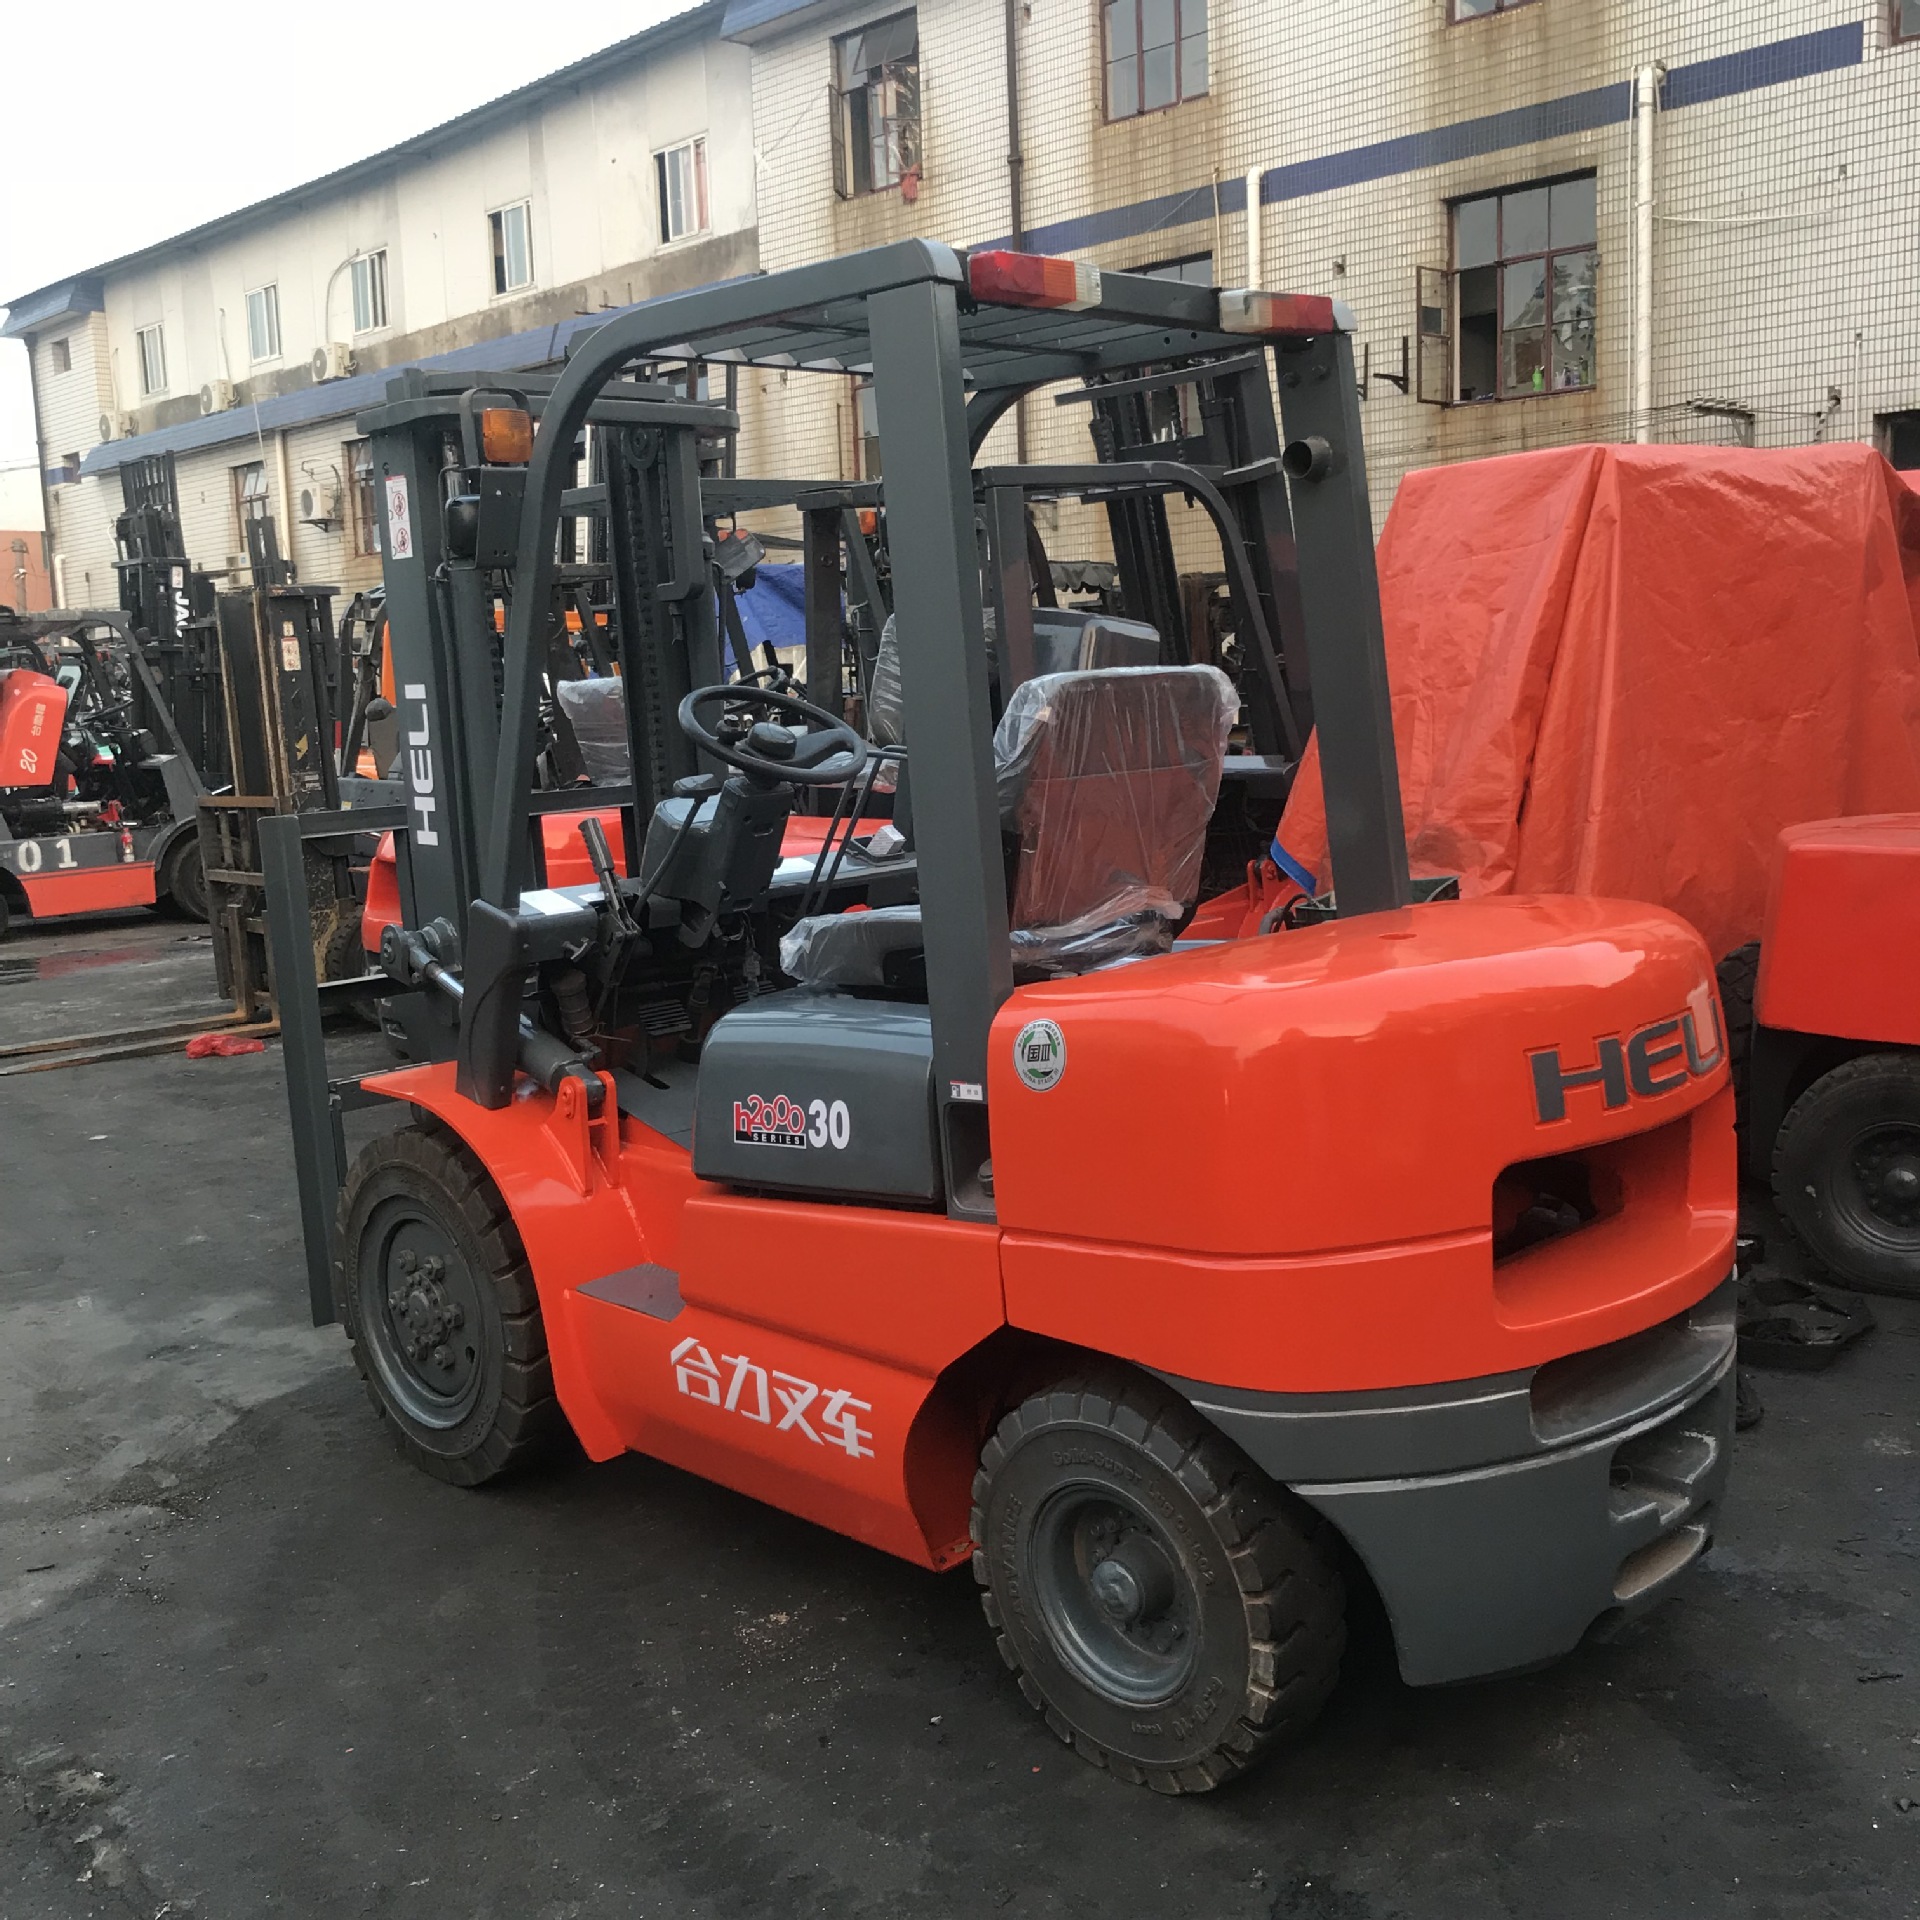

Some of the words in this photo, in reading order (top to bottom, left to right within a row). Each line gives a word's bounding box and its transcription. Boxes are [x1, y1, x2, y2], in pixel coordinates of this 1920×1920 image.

[20, 748, 38, 774] 20
[404, 683, 439, 846] HELI
[752, 1132, 801, 1146] SERIES
[808, 1099, 851, 1150] 30
[670, 1336, 876, 1459] 合力叉车
